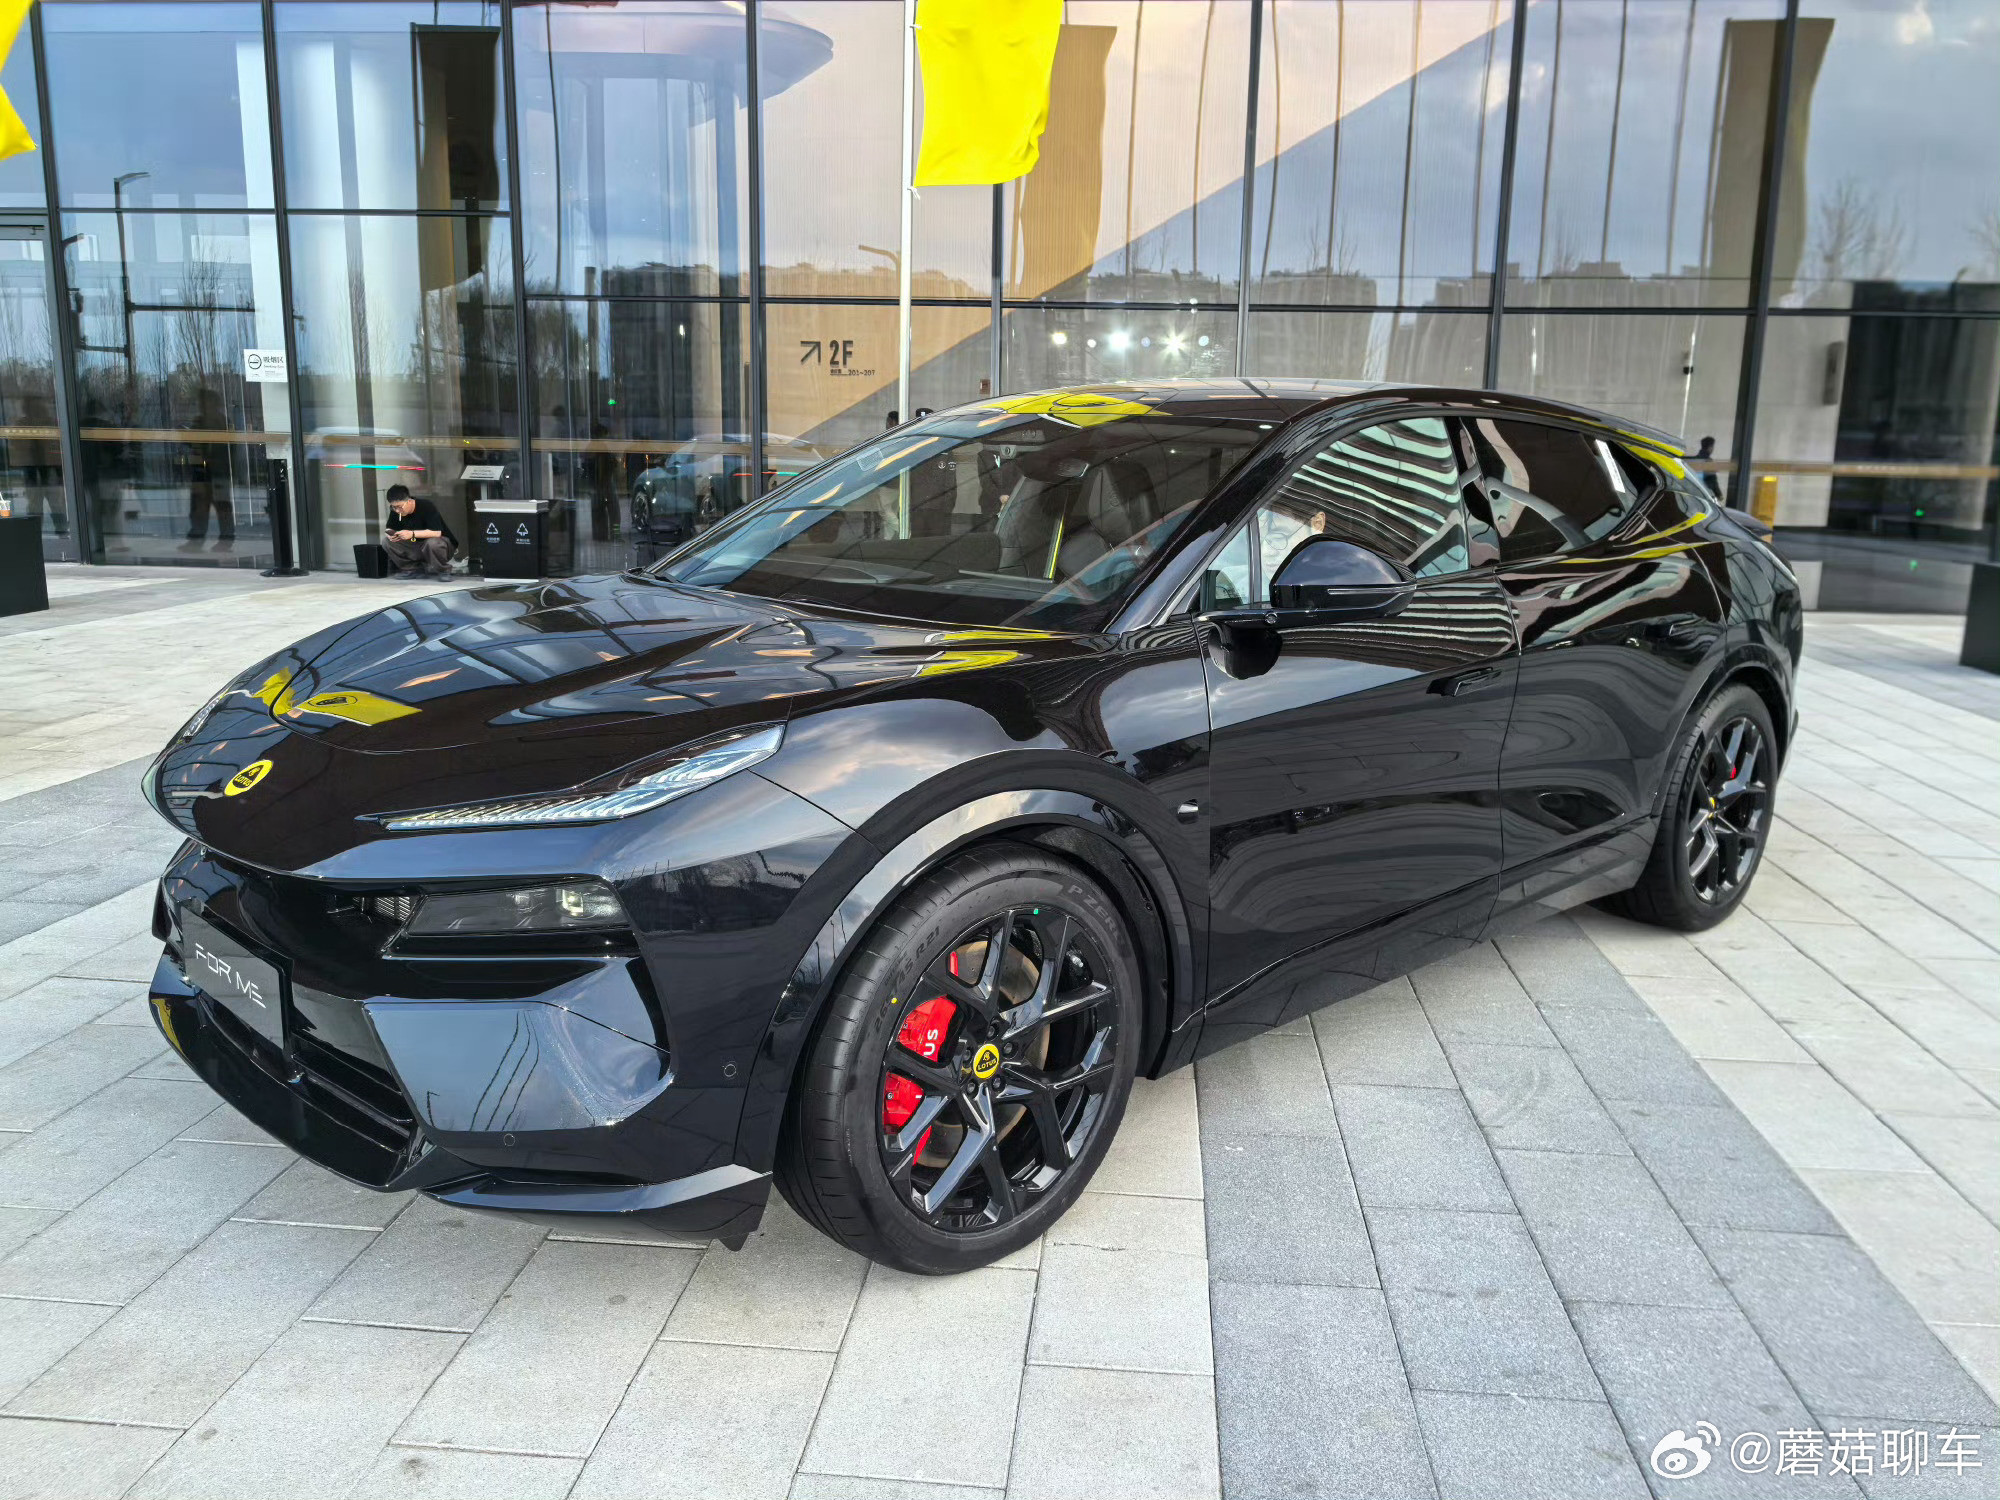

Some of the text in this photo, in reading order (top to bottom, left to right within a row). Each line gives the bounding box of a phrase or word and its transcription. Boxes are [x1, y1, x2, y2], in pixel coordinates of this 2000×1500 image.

[829, 340, 854, 366] 2F
[195, 943, 267, 1009] FOR ME
[977, 1058, 997, 1071] LOTUS
